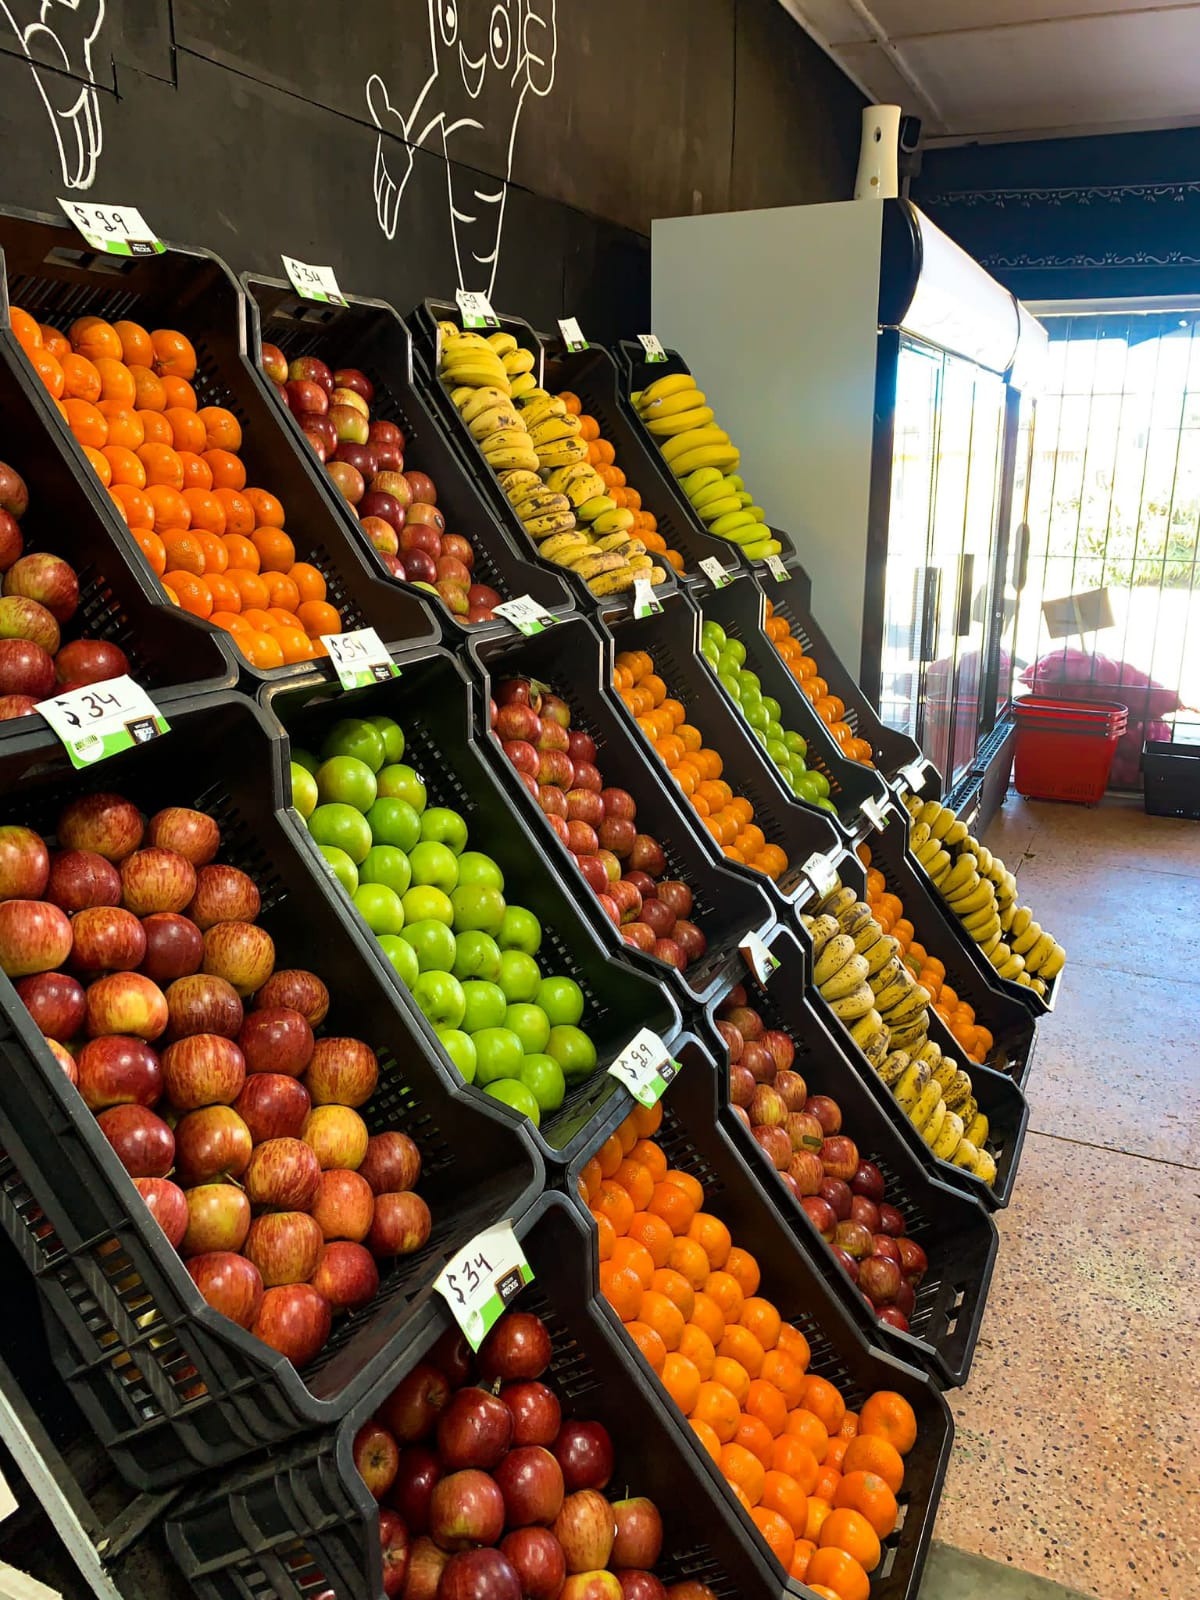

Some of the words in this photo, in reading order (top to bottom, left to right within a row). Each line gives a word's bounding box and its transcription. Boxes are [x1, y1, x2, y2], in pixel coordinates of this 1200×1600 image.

[291, 261, 323, 286] $34
[330, 637, 368, 663] $54
[55, 692, 121, 728] $34
[446, 1252, 493, 1305] $34
